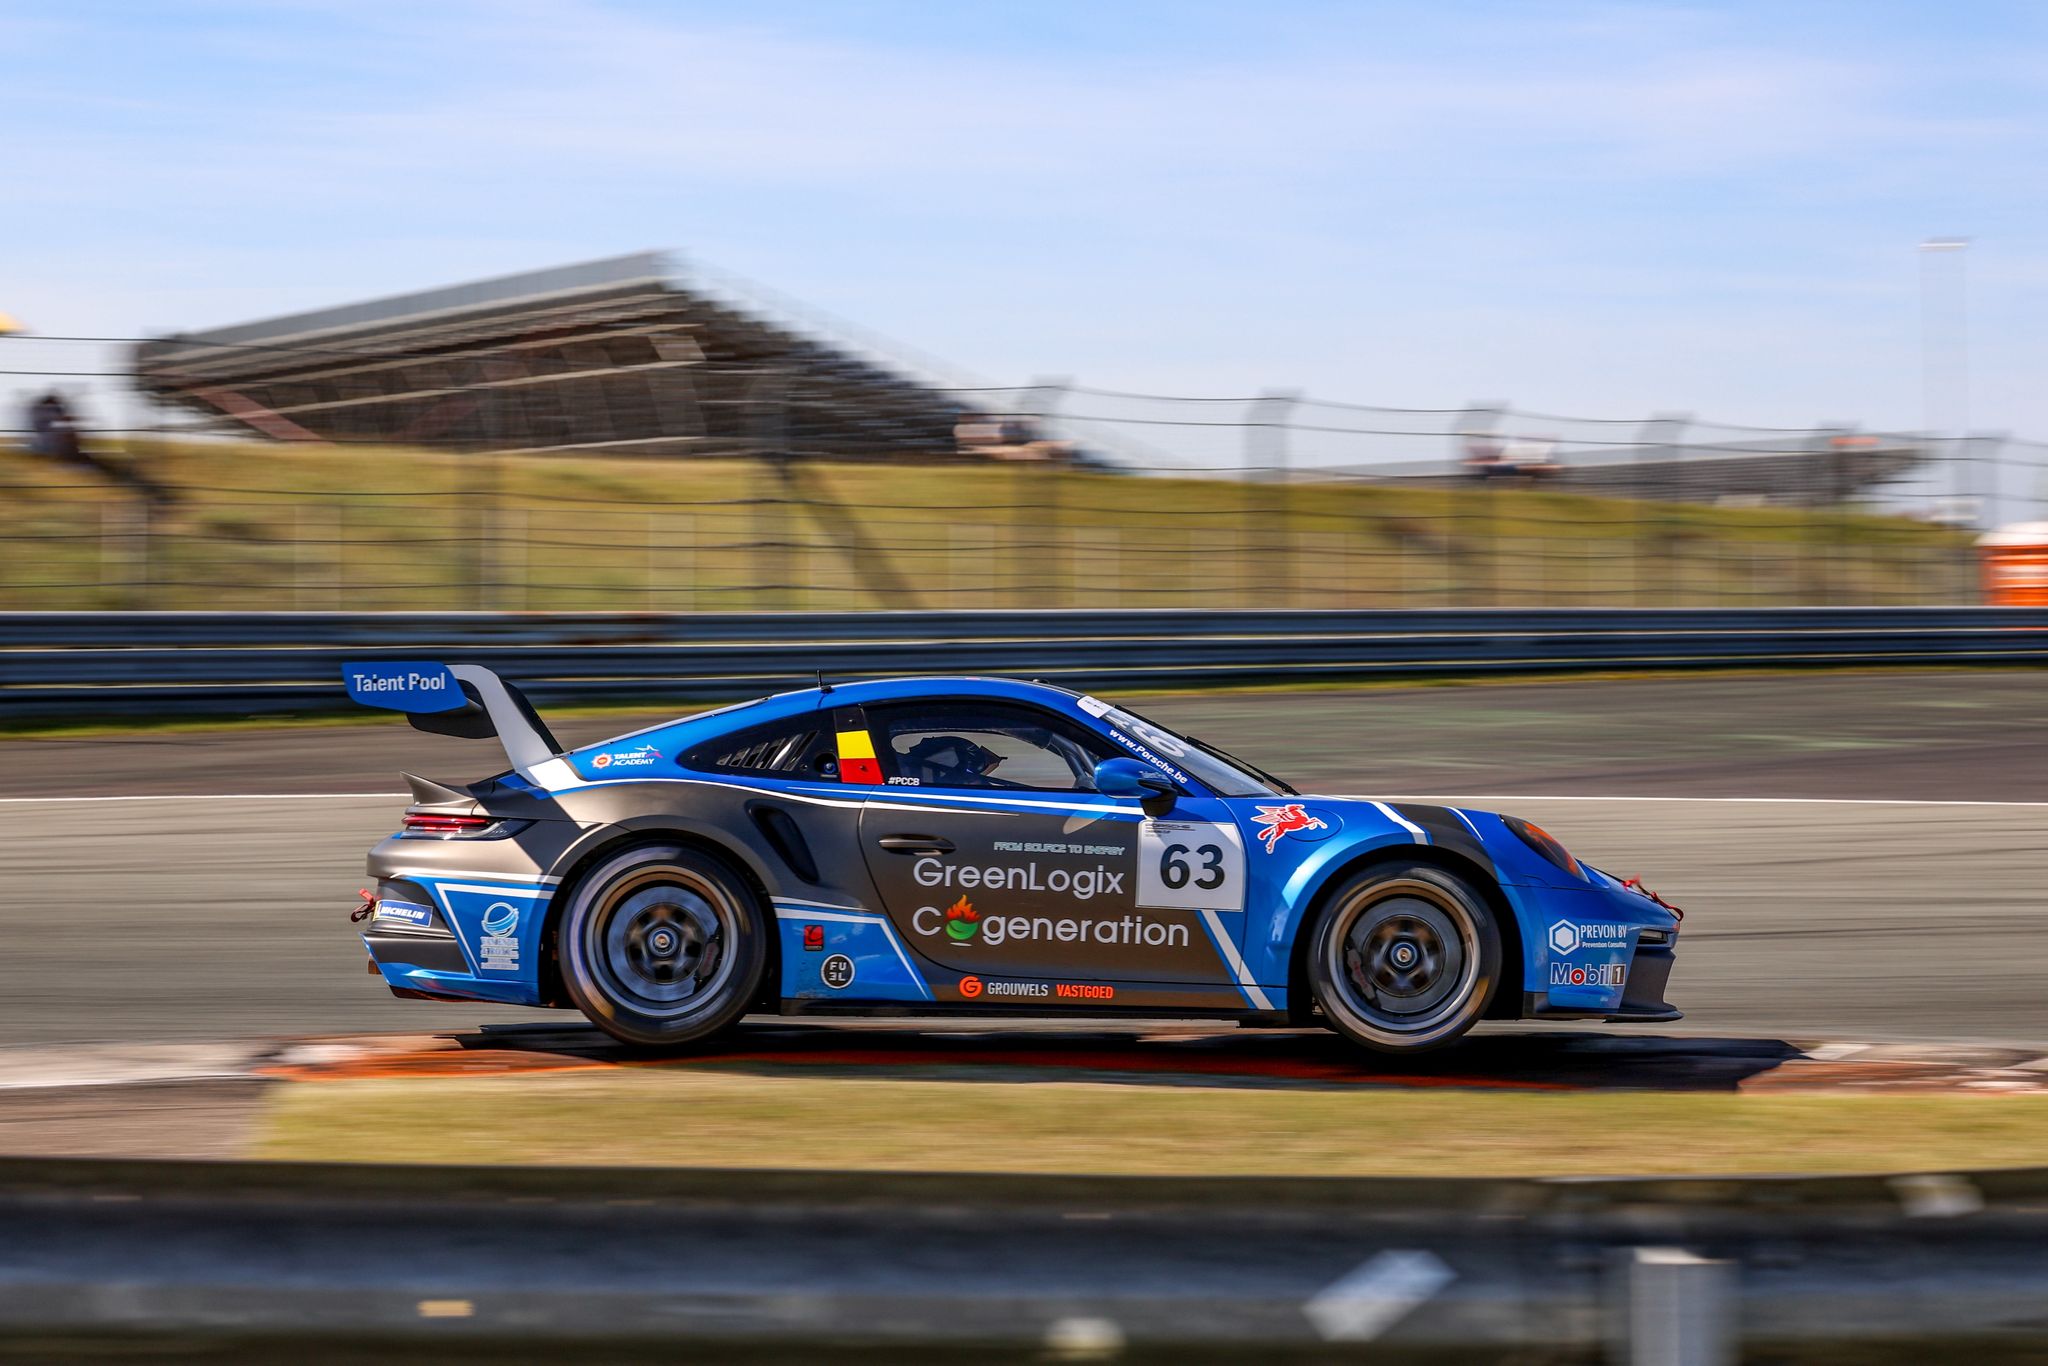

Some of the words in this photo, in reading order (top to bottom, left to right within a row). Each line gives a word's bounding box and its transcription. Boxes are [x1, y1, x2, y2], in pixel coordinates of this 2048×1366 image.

[353, 674, 405, 692] Talent
[408, 672, 445, 690] Pool
[614, 752, 647, 760] TALENT
[1109, 729, 1188, 784] www.Porsche.be
[888, 777, 920, 786] #PCCB
[994, 841, 1023, 852] FROM
[1024, 842, 1067, 853] SOURCE
[1068, 844, 1083, 854] TO
[1160, 843, 1225, 890] 63
[913, 857, 1125, 900] GreenLogix
[1580, 925, 1616, 938] PREVON
[1550, 962, 1611, 986] Mobil
[987, 982, 1049, 997] GROUWELS
[1056, 984, 1114, 999] VASTGOED
